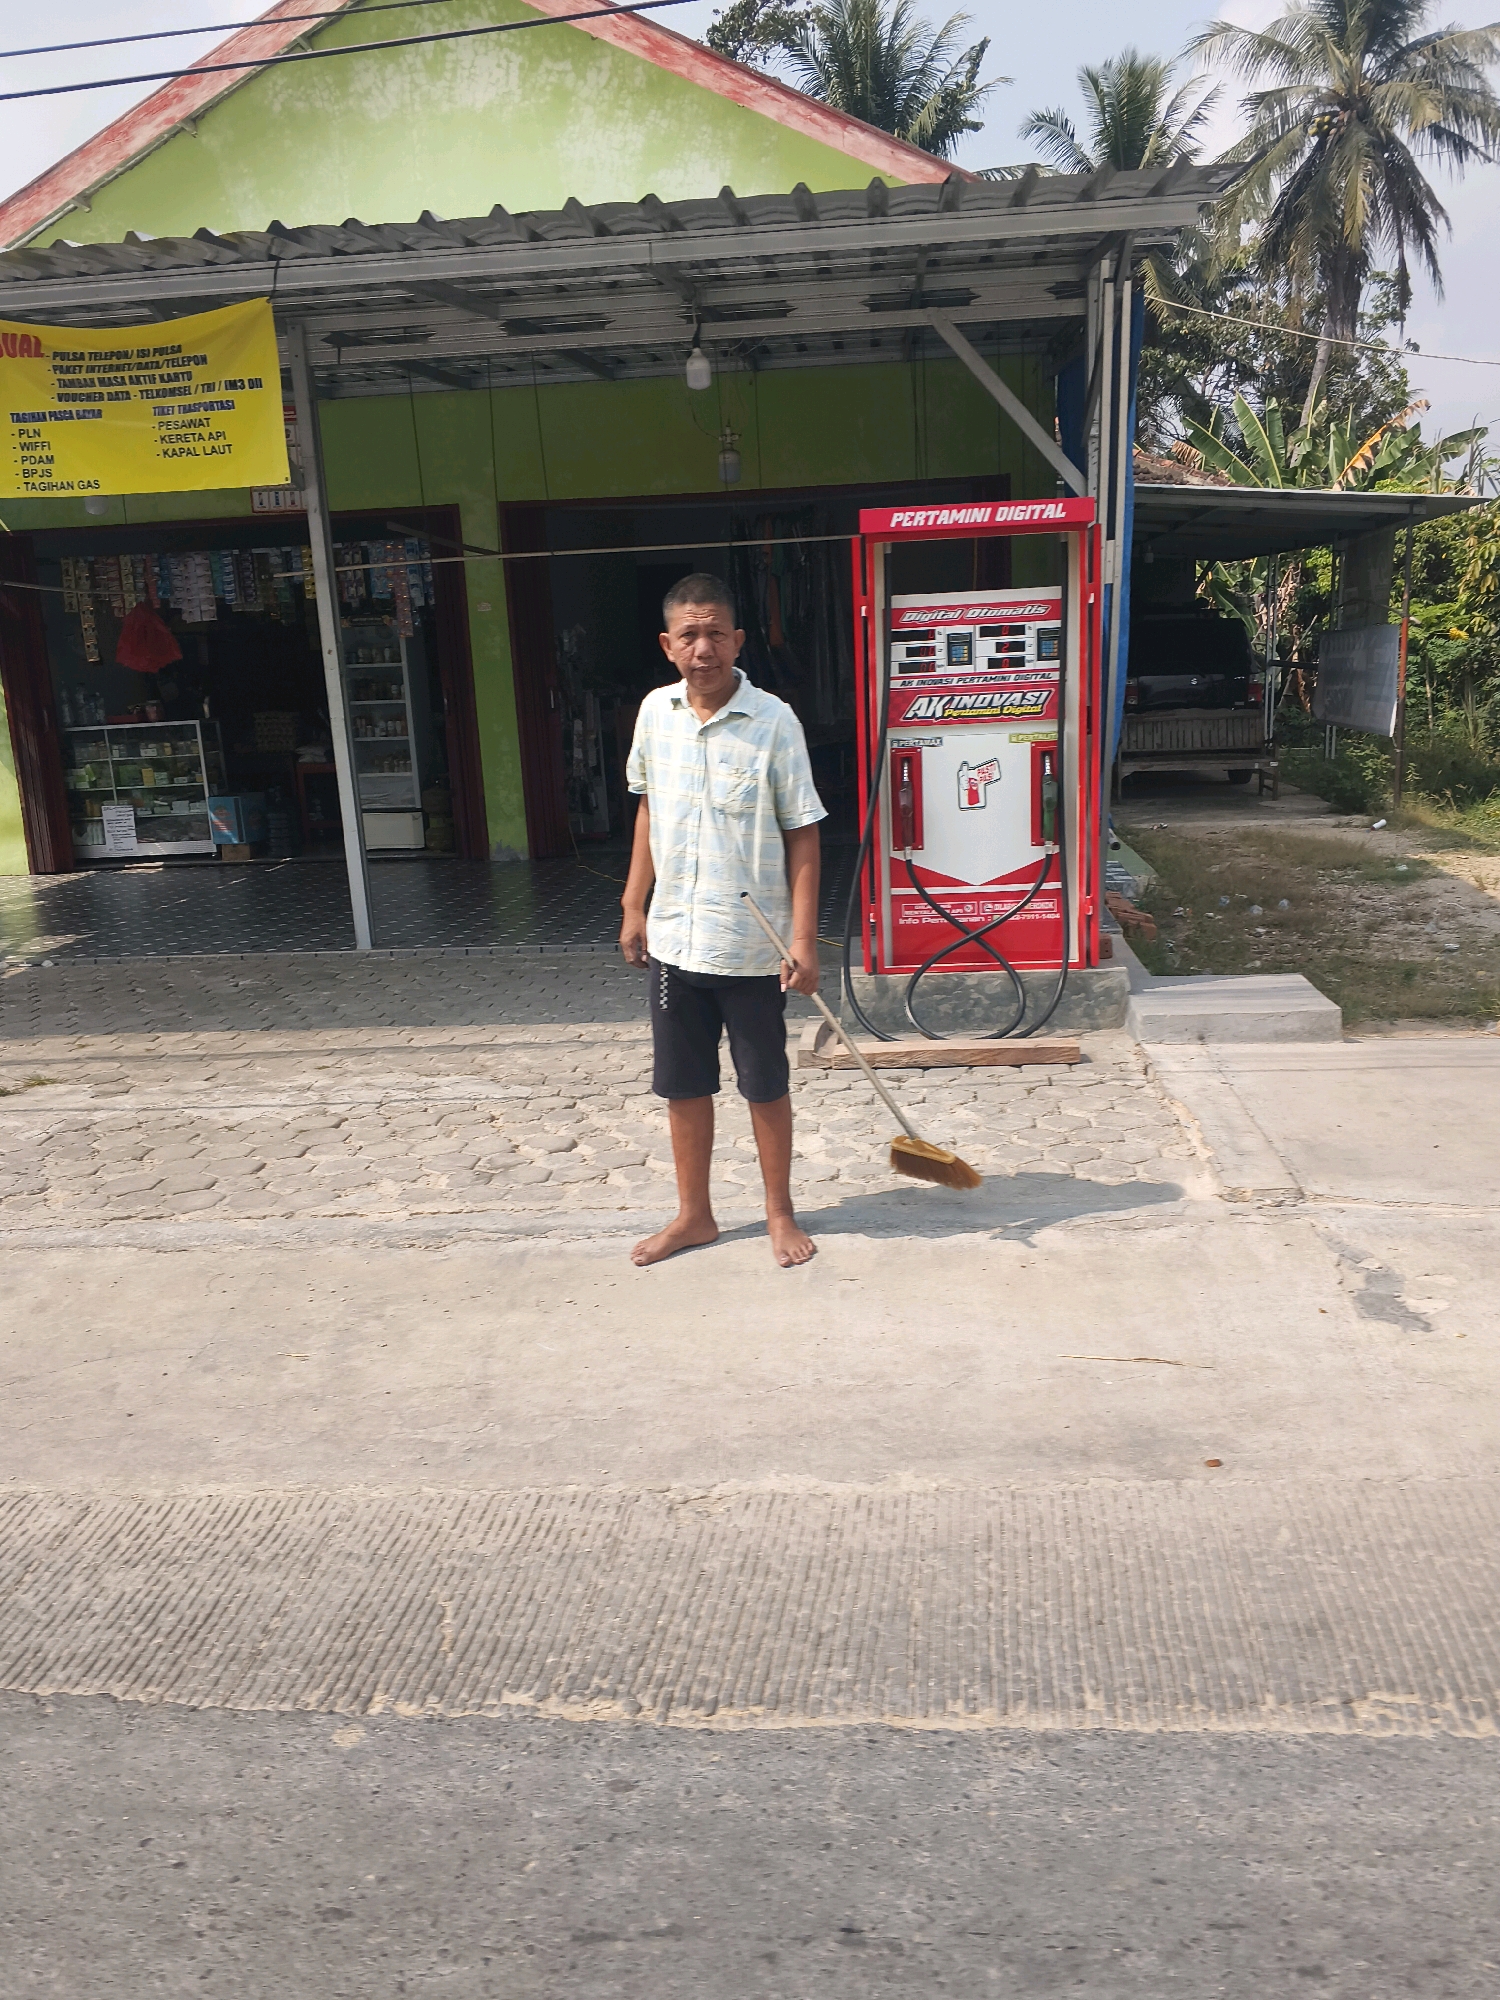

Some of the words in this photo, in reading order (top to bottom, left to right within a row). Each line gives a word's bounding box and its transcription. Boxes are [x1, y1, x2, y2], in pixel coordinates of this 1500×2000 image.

[52, 351, 86, 361] PULSA
[153, 344, 182, 357] PULSA
[52, 364, 83, 374] PAKET
[97, 376, 127, 387] MASA
[128, 374, 157, 385] AKTIF
[158, 371, 192, 383] KARTU
[56, 392, 104, 402] VOUCHER
[106, 391, 131, 401] DATA
[139, 385, 192, 400] TELKOMSEL
[201, 382, 216, 393] TRI
[9, 412, 48, 423] TAGIHAN
[158, 417, 211, 430] PESAWAT
[18, 428, 41, 438] PLN
[160, 432, 206, 444] KERETA
[208, 431, 226, 442] API
[19, 441, 51, 451] WIFFI
[162, 446, 200, 458] KAPAL
[203, 444, 232, 456] LAUT
[21, 455, 54, 465] PDAM
[23, 468, 52, 478] BPJS
[24, 480, 74, 491] TAGIHAN
[77, 479, 100, 489] GAS
[890, 507, 992, 528] PERTAMINI
[995, 502, 1067, 522] DIGITAL
[901, 608, 963, 623] Digital
[965, 604, 1048, 619] Otomatis
[916, 678, 954, 687] INOVASI
[956, 674, 1011, 684] PERTAMINI
[1013, 672, 1052, 682] DIGITAL
[905, 695, 952, 718] AK
[947, 690, 1051, 709] INOVASI
[943, 706, 1000, 717] Pertamini
[1002, 704, 1042, 715] Digital
[899, 738, 941, 747] PERTAMAX
[898, 917, 920, 925] Info
